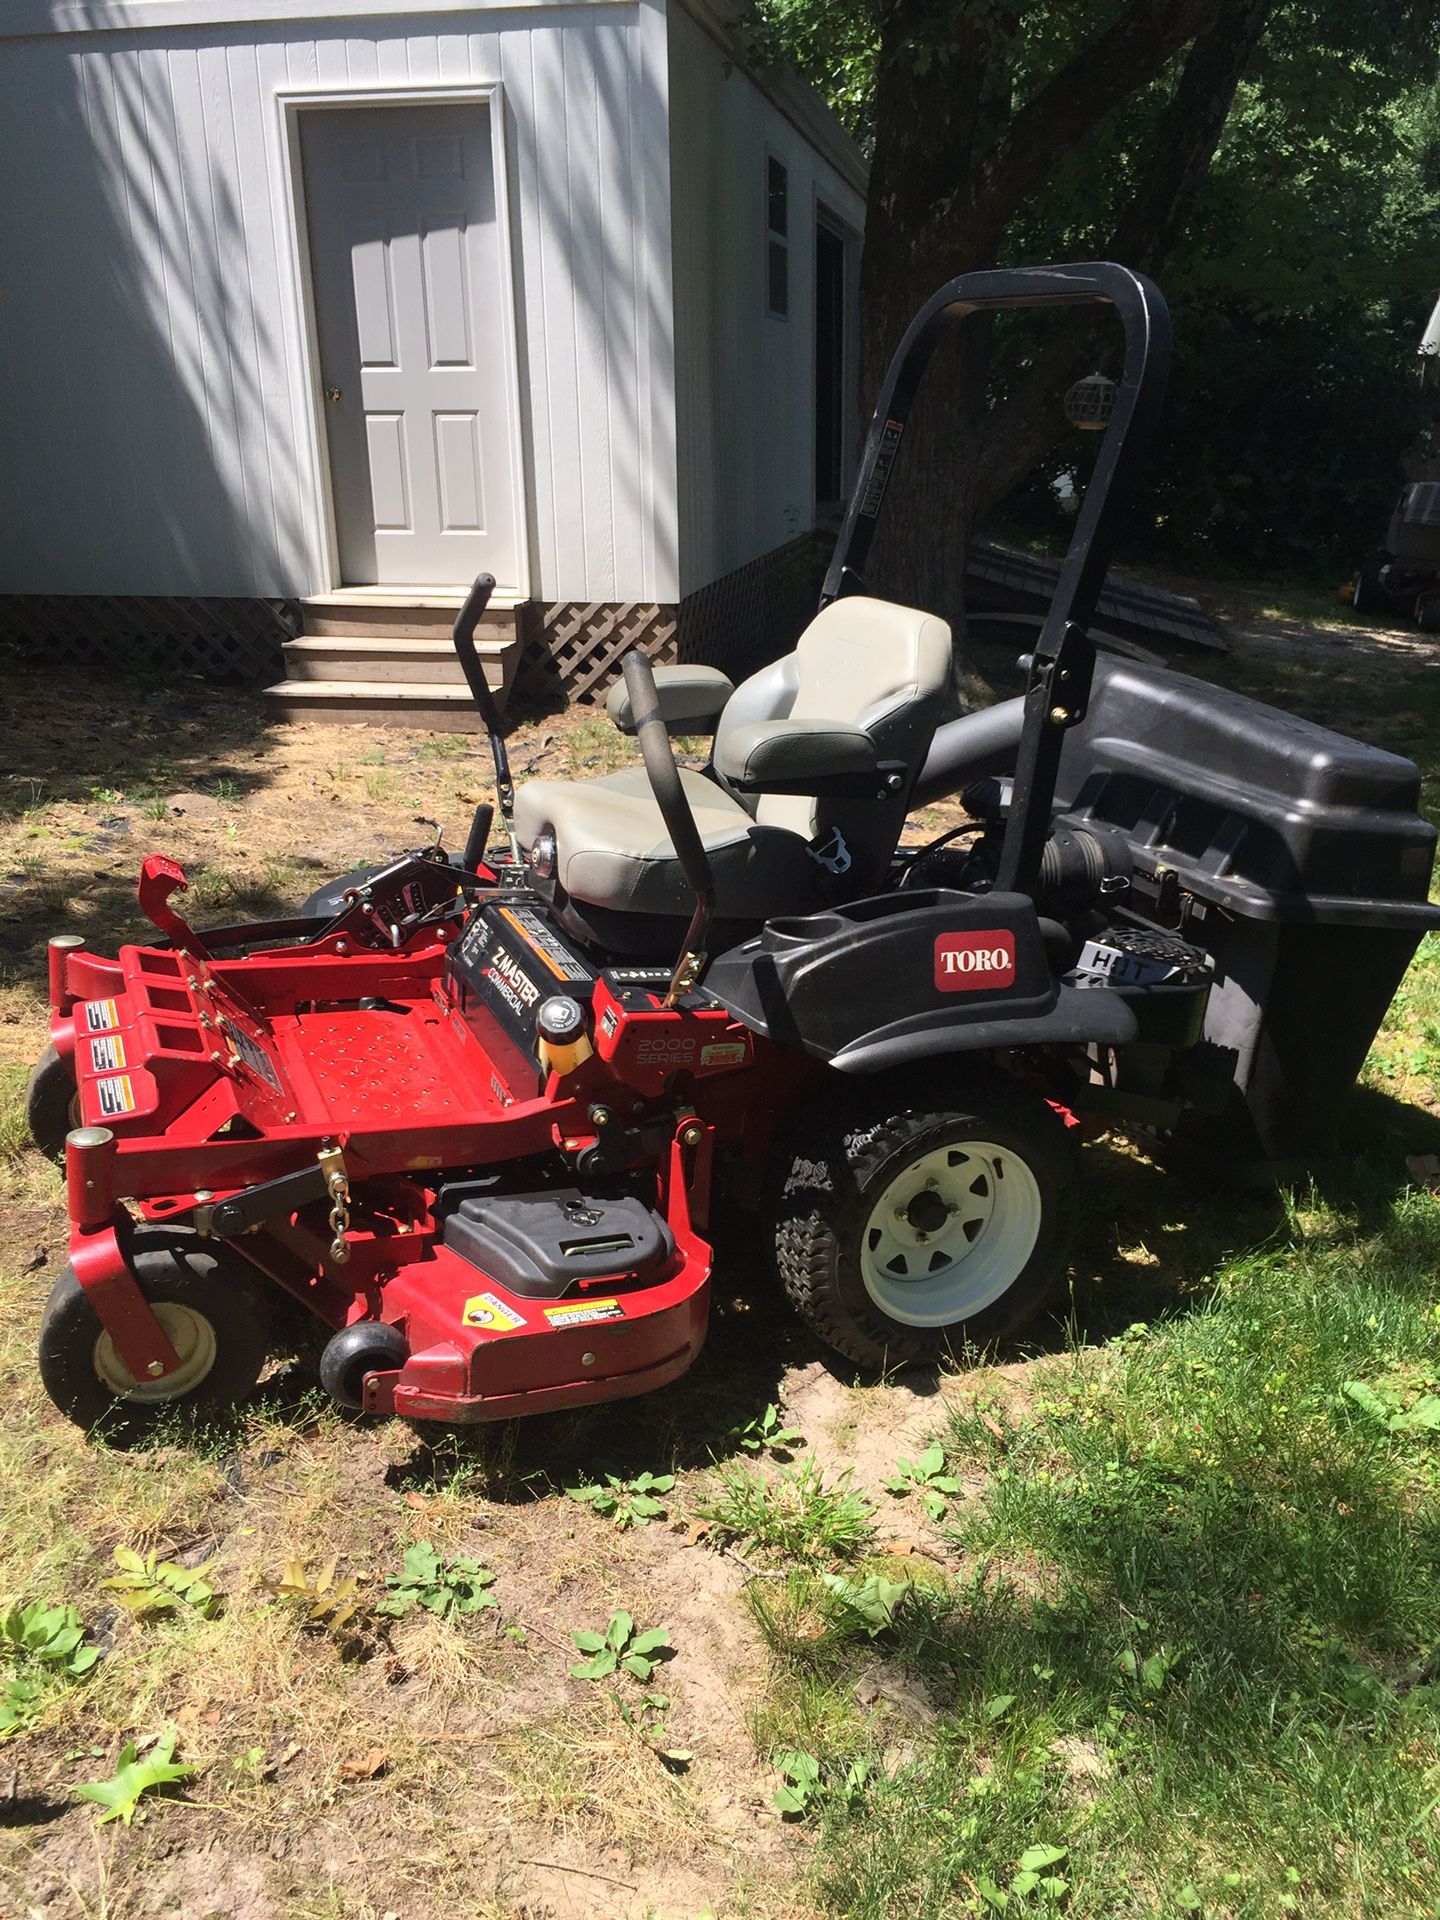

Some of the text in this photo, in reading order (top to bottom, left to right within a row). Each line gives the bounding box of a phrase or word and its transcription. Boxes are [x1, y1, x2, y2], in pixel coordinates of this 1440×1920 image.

[941, 948, 1008, 974] TORO
[492, 946, 539, 1008] Z MASTER
[487, 967, 524, 1016] COMMERCIAL
[638, 1038, 696, 1051] 2000
[636, 1052, 694, 1065] SERIES
[484, 1295, 521, 1323] DANGER
